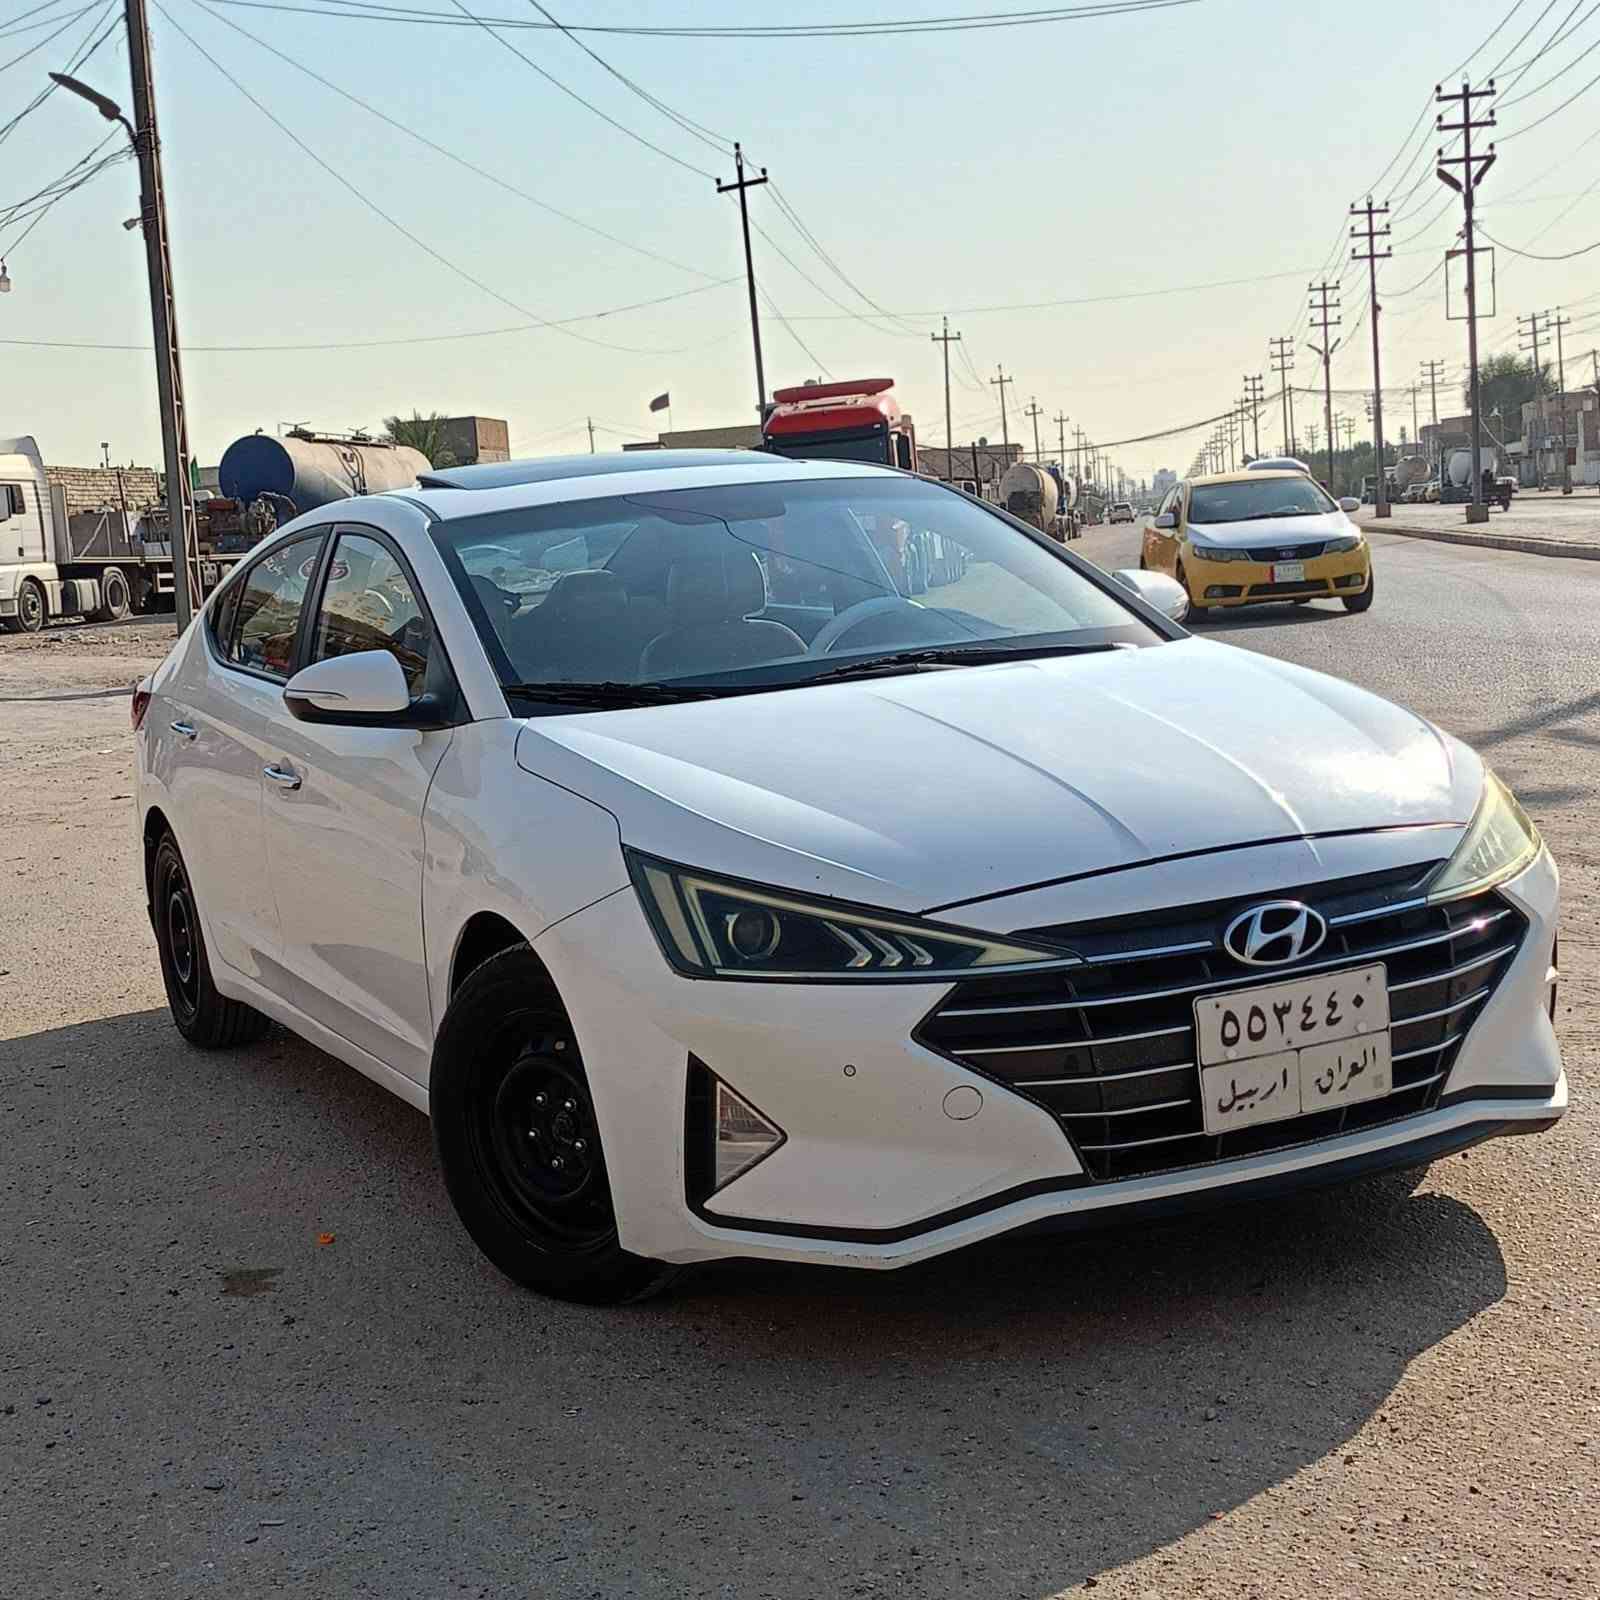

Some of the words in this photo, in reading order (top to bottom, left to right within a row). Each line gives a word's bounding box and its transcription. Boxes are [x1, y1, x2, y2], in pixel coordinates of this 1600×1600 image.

[1221, 990, 1364, 1047] ٥٥٣٤٤٠
[1217, 1067, 1288, 1114] اربيل
[1314, 1046, 1377, 1095] العراق
